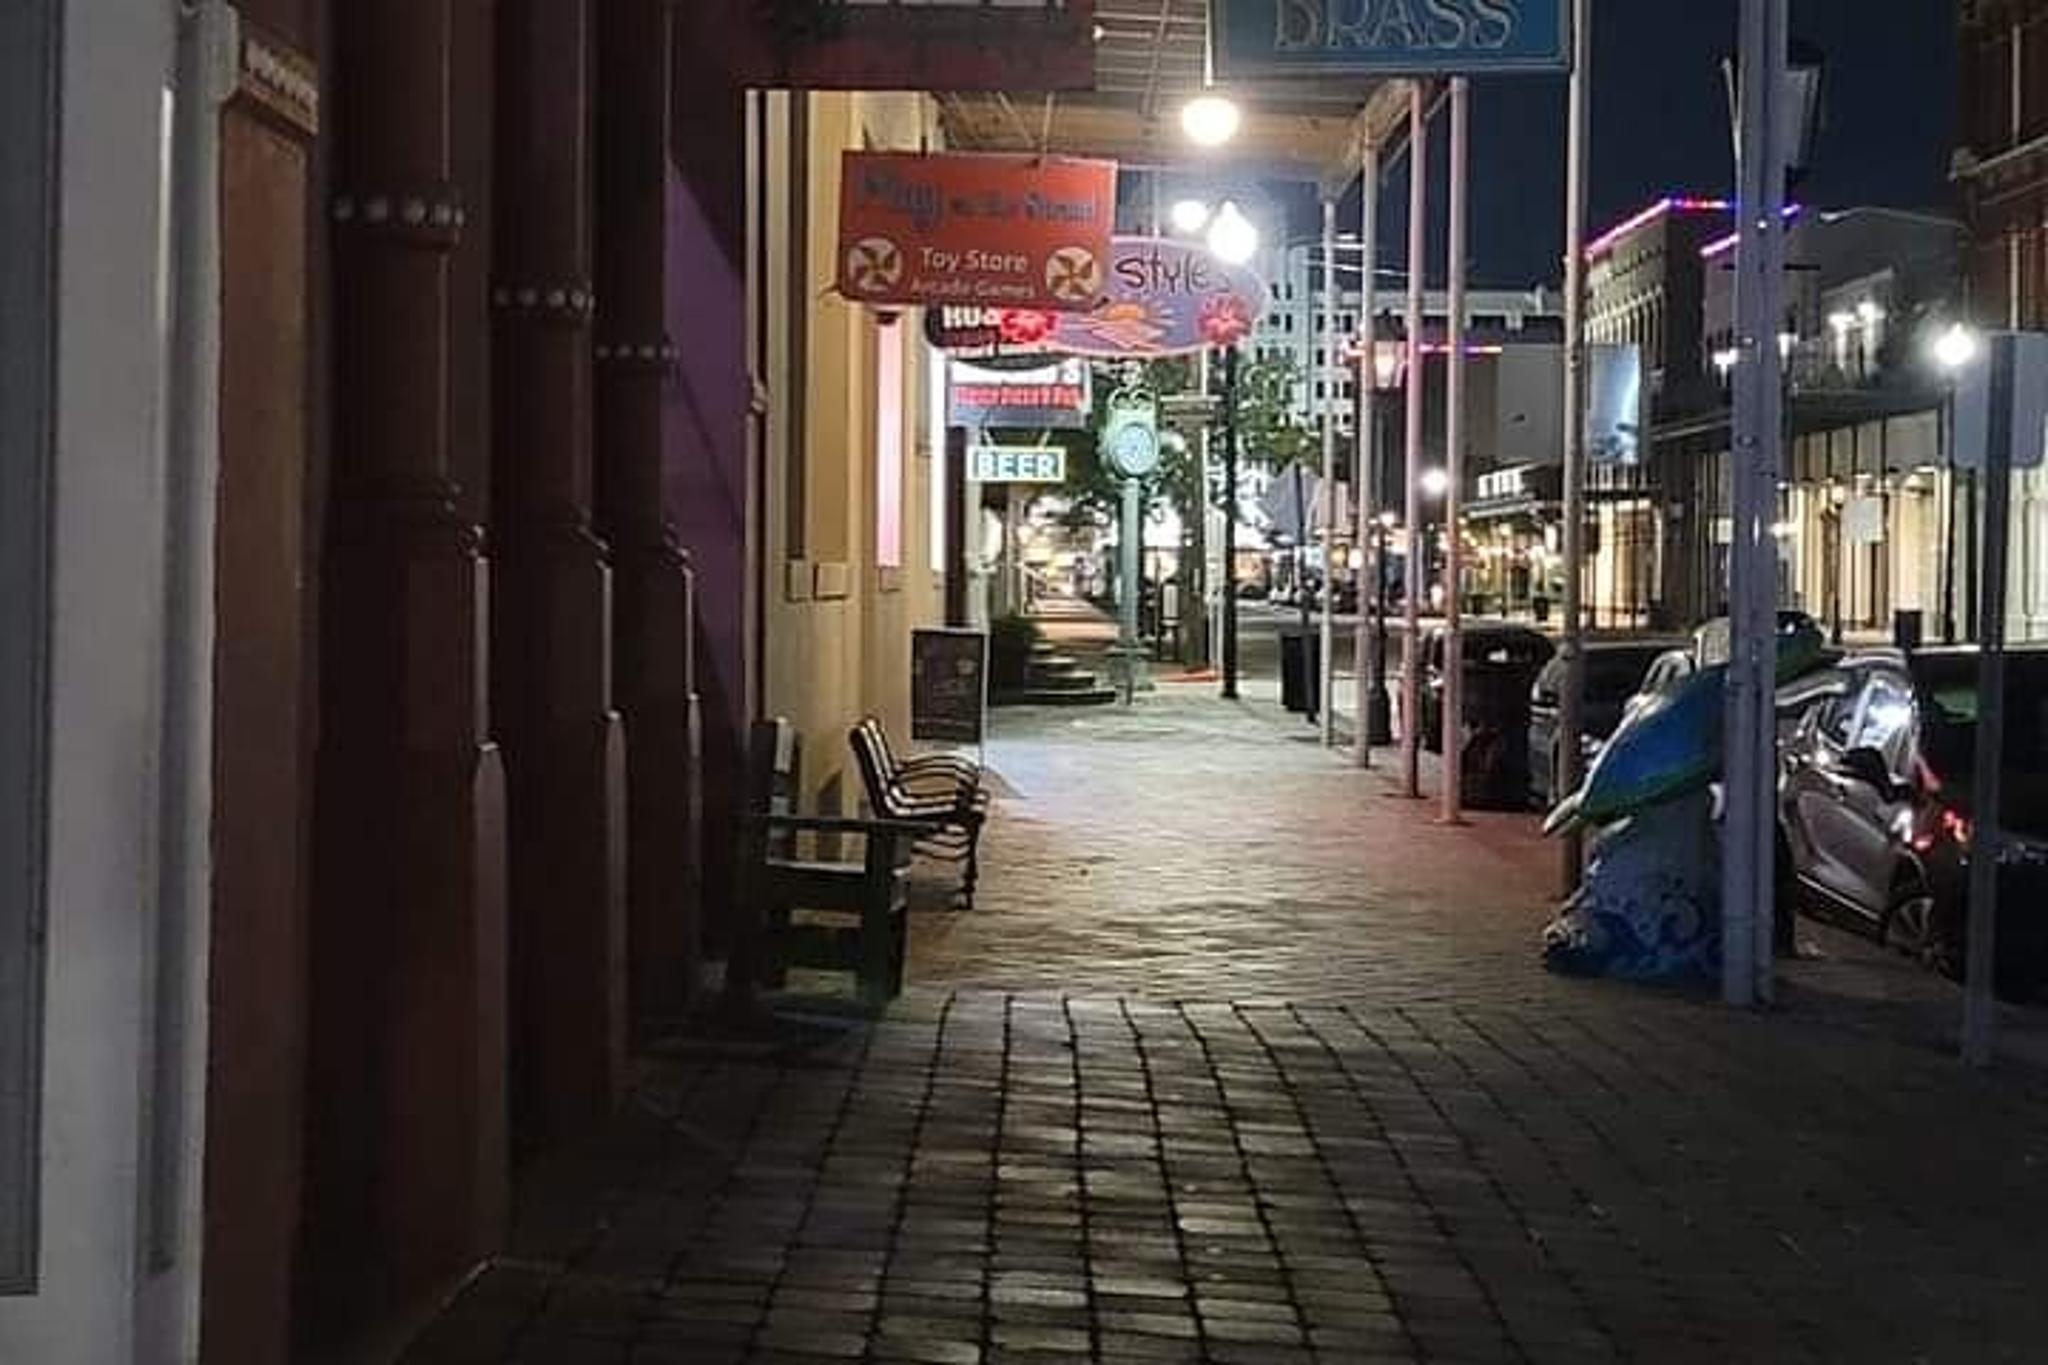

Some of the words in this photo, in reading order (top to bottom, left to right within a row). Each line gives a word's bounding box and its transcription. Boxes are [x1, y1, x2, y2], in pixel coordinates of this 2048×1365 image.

[1275, 0, 1512, 49] BRASS
[920, 247, 958, 272] Toy
[963, 249, 1029, 272] Store
[974, 277, 1036, 297] Games
[974, 452, 1059, 478] BEER
